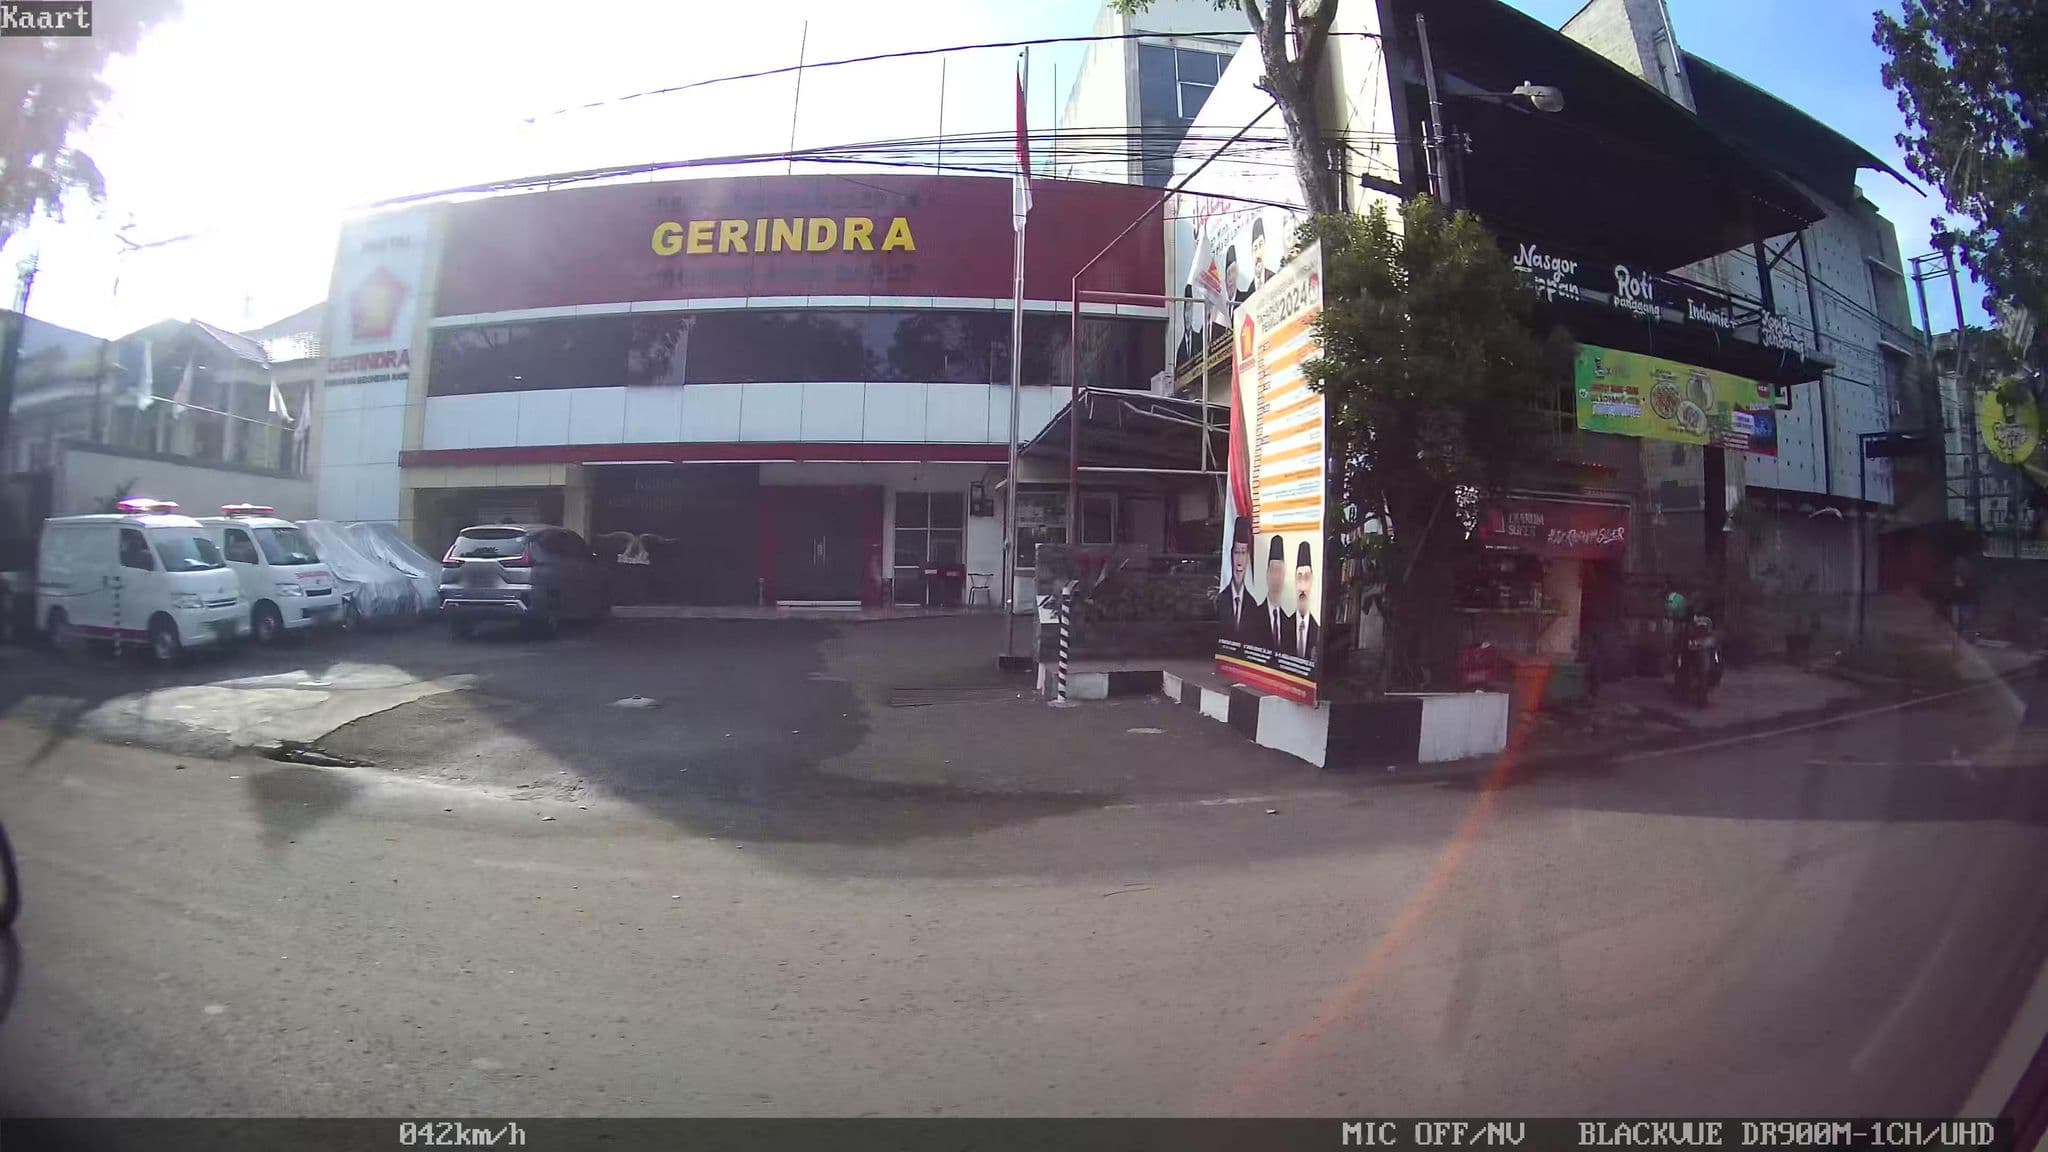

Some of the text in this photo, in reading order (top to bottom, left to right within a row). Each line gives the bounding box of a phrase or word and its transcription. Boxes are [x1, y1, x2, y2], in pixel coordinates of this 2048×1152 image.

[651, 216, 917, 257] GERINDRA
[1513, 243, 1578, 282] Nasgor
[1614, 264, 1653, 300] Roti
[1280, 281, 1308, 321] 2024
[327, 348, 410, 374] GERINDRA
